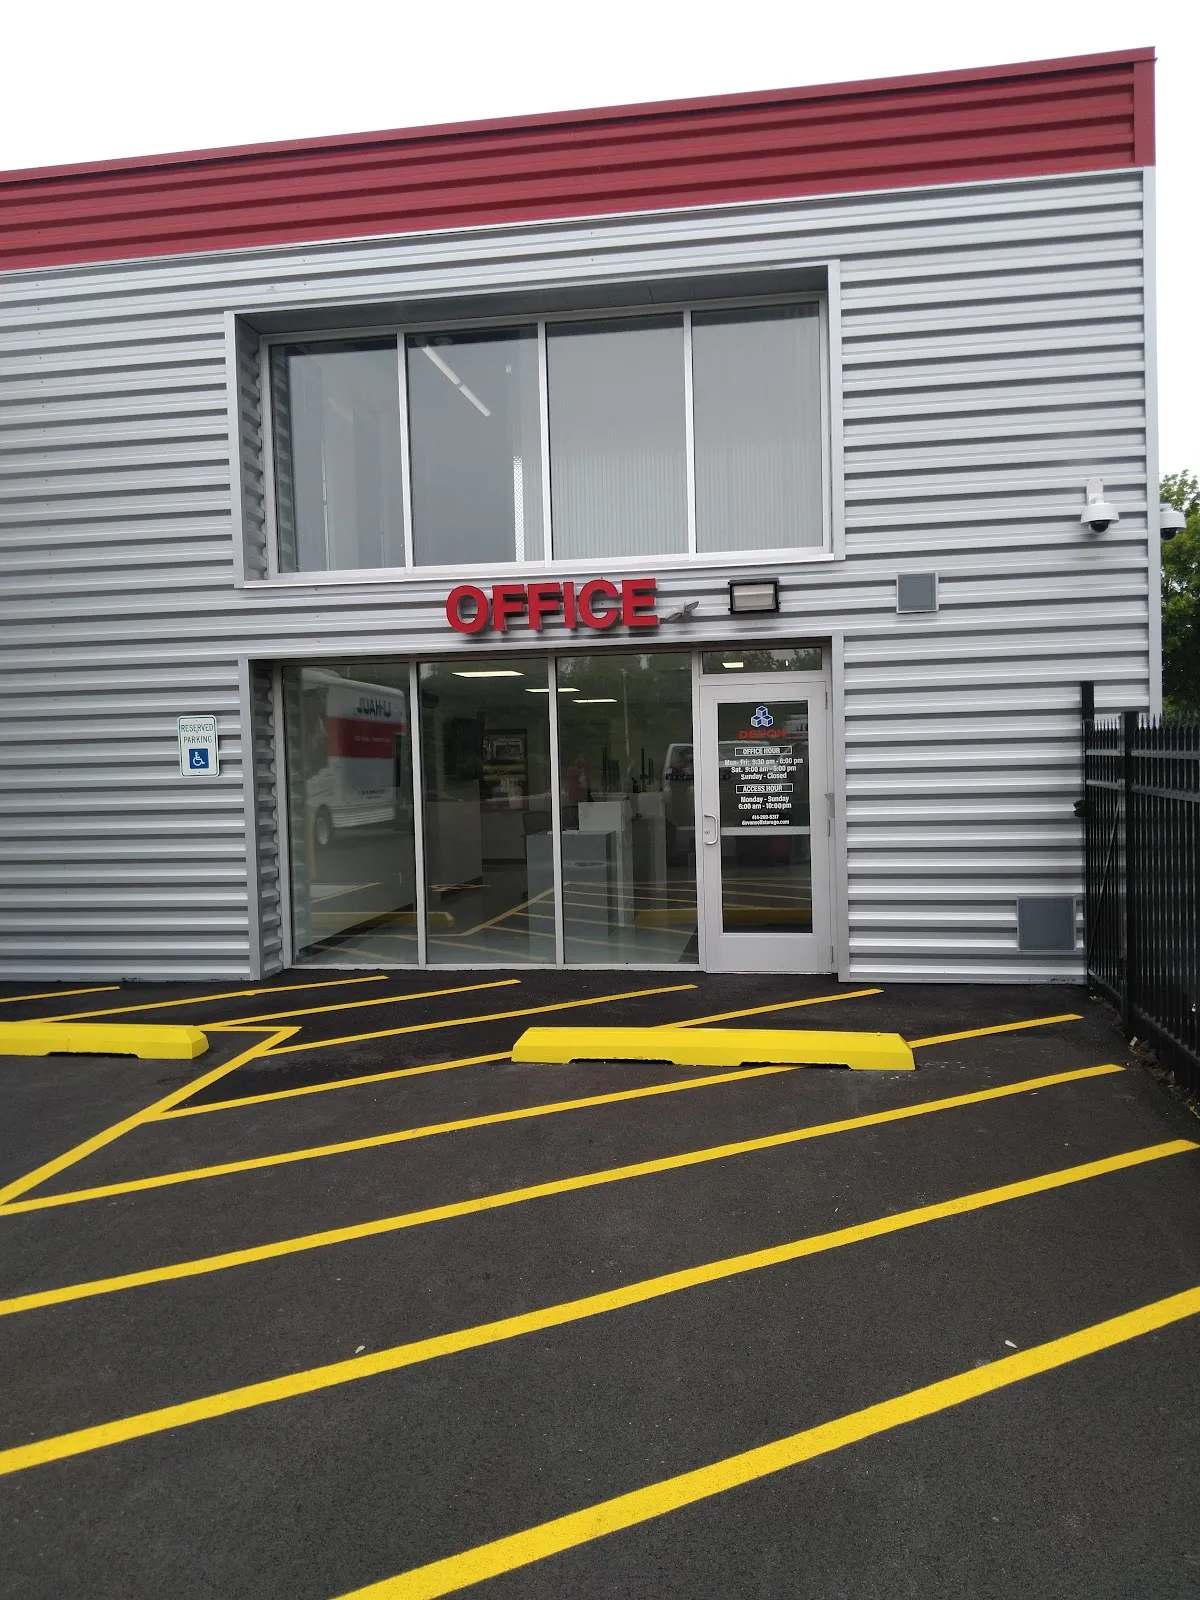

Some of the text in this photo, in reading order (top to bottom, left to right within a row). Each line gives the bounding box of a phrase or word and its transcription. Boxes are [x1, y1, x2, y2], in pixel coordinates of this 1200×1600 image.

[446, 578, 660, 634] OFFICE
[181, 723, 214, 732] RESERVED
[183, 735, 213, 744] PARKING
[767, 795, 789, 803] Sunday
